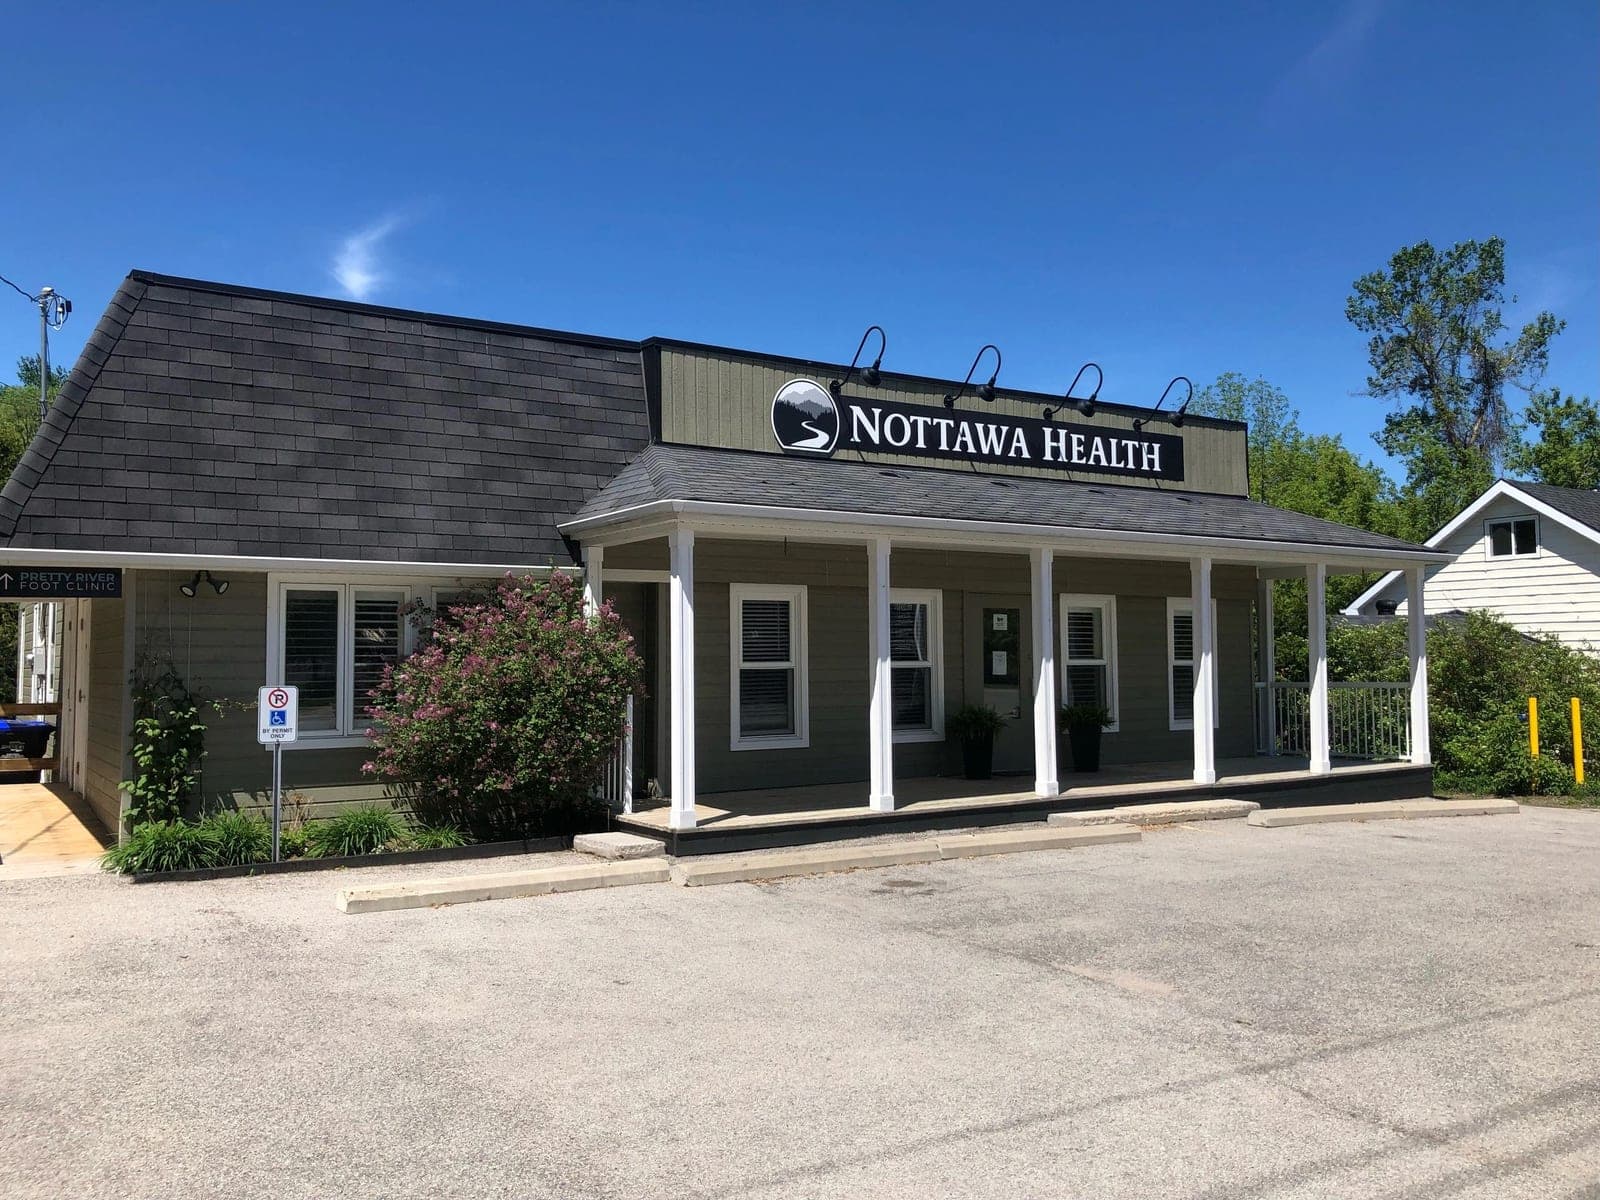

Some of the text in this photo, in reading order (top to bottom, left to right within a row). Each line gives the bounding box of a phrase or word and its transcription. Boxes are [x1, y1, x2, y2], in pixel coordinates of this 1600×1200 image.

[850, 405, 1162, 472] NOTTAWA HEALTH
[20, 572, 115, 582] PRETTY RIVER
[20, 581, 115, 591] FOOT CLINIC
[274, 694, 284, 704] P
